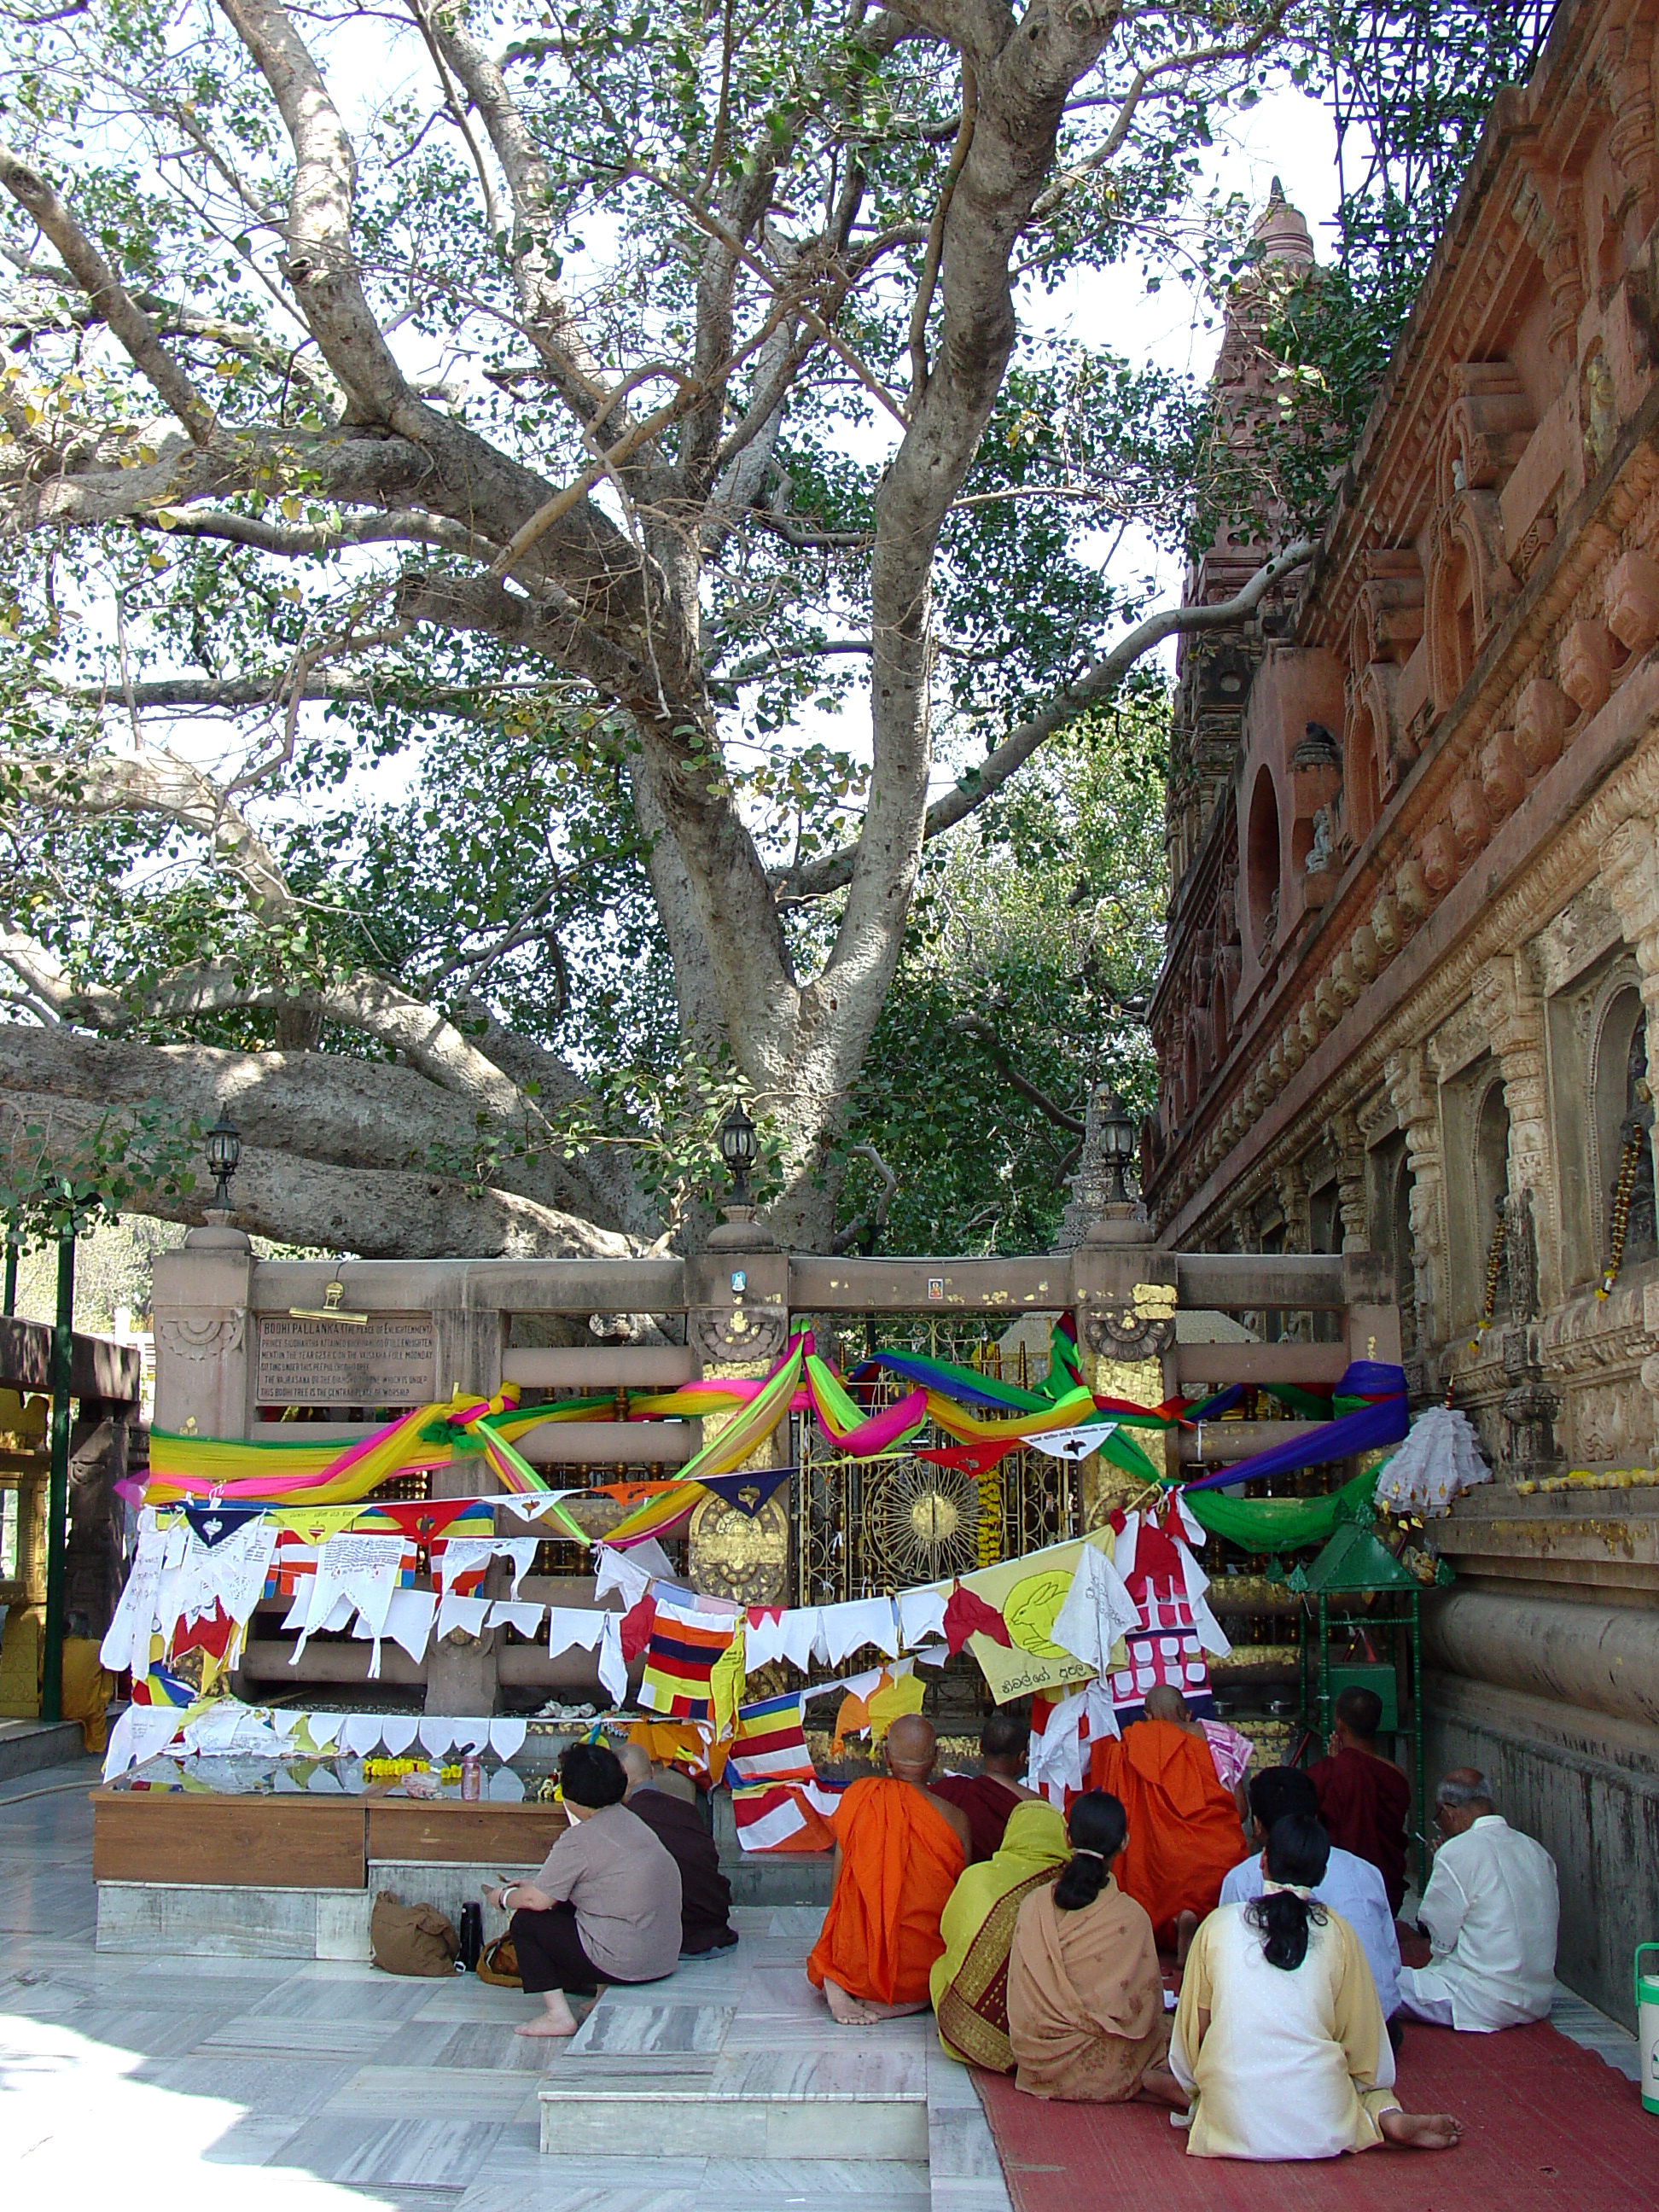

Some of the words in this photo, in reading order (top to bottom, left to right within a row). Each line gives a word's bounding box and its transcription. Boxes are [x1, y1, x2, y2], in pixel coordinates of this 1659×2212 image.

[265, 1323, 289, 1334] BODHI
[292, 1323, 339, 1334] PALLANKA
[262, 1339, 282, 1348] PRINCE
[261, 1388, 274, 1396] THIS
[275, 1388, 293, 1396] BODHI
[294, 1388, 309, 1396] TREE
[317, 1388, 327, 1396] THE
[329, 1388, 352, 1396] CENTRAL
